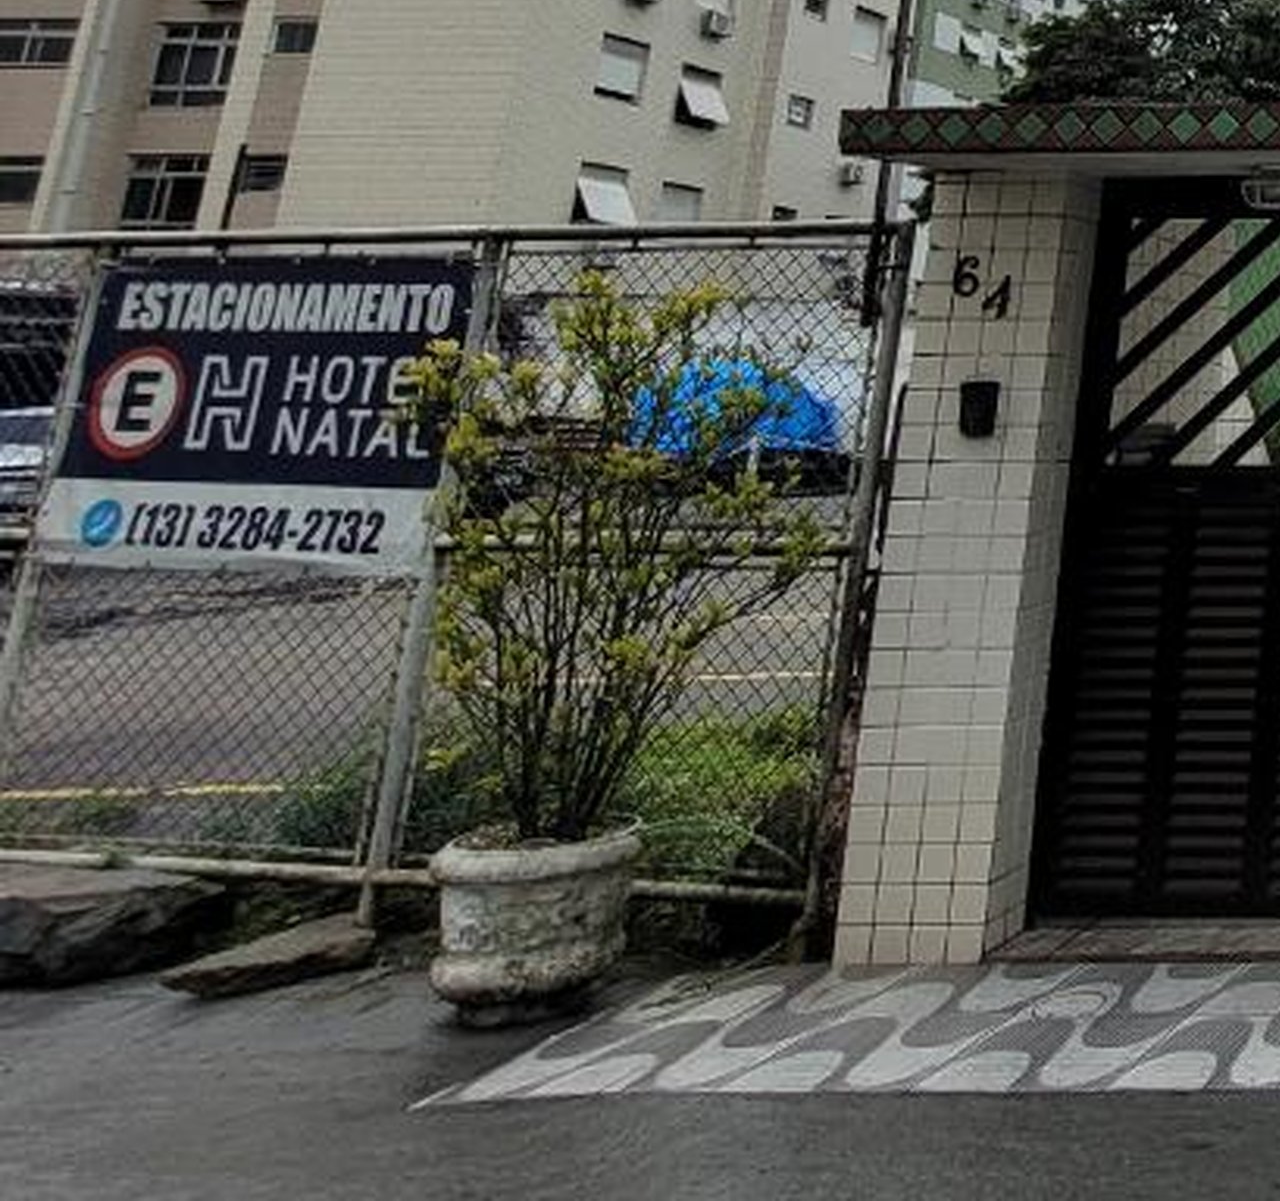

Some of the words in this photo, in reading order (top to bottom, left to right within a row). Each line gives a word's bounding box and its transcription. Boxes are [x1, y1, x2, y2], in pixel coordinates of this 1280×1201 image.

[116, 281, 456, 335] ESTACIONAMENTO
[953, 254, 1012, 320] 64
[113, 370, 163, 432] E
[282, 354, 428, 405] HOTE
[268, 405, 430, 459] NATAL
[196, 504, 386, 555] 3284-2732
